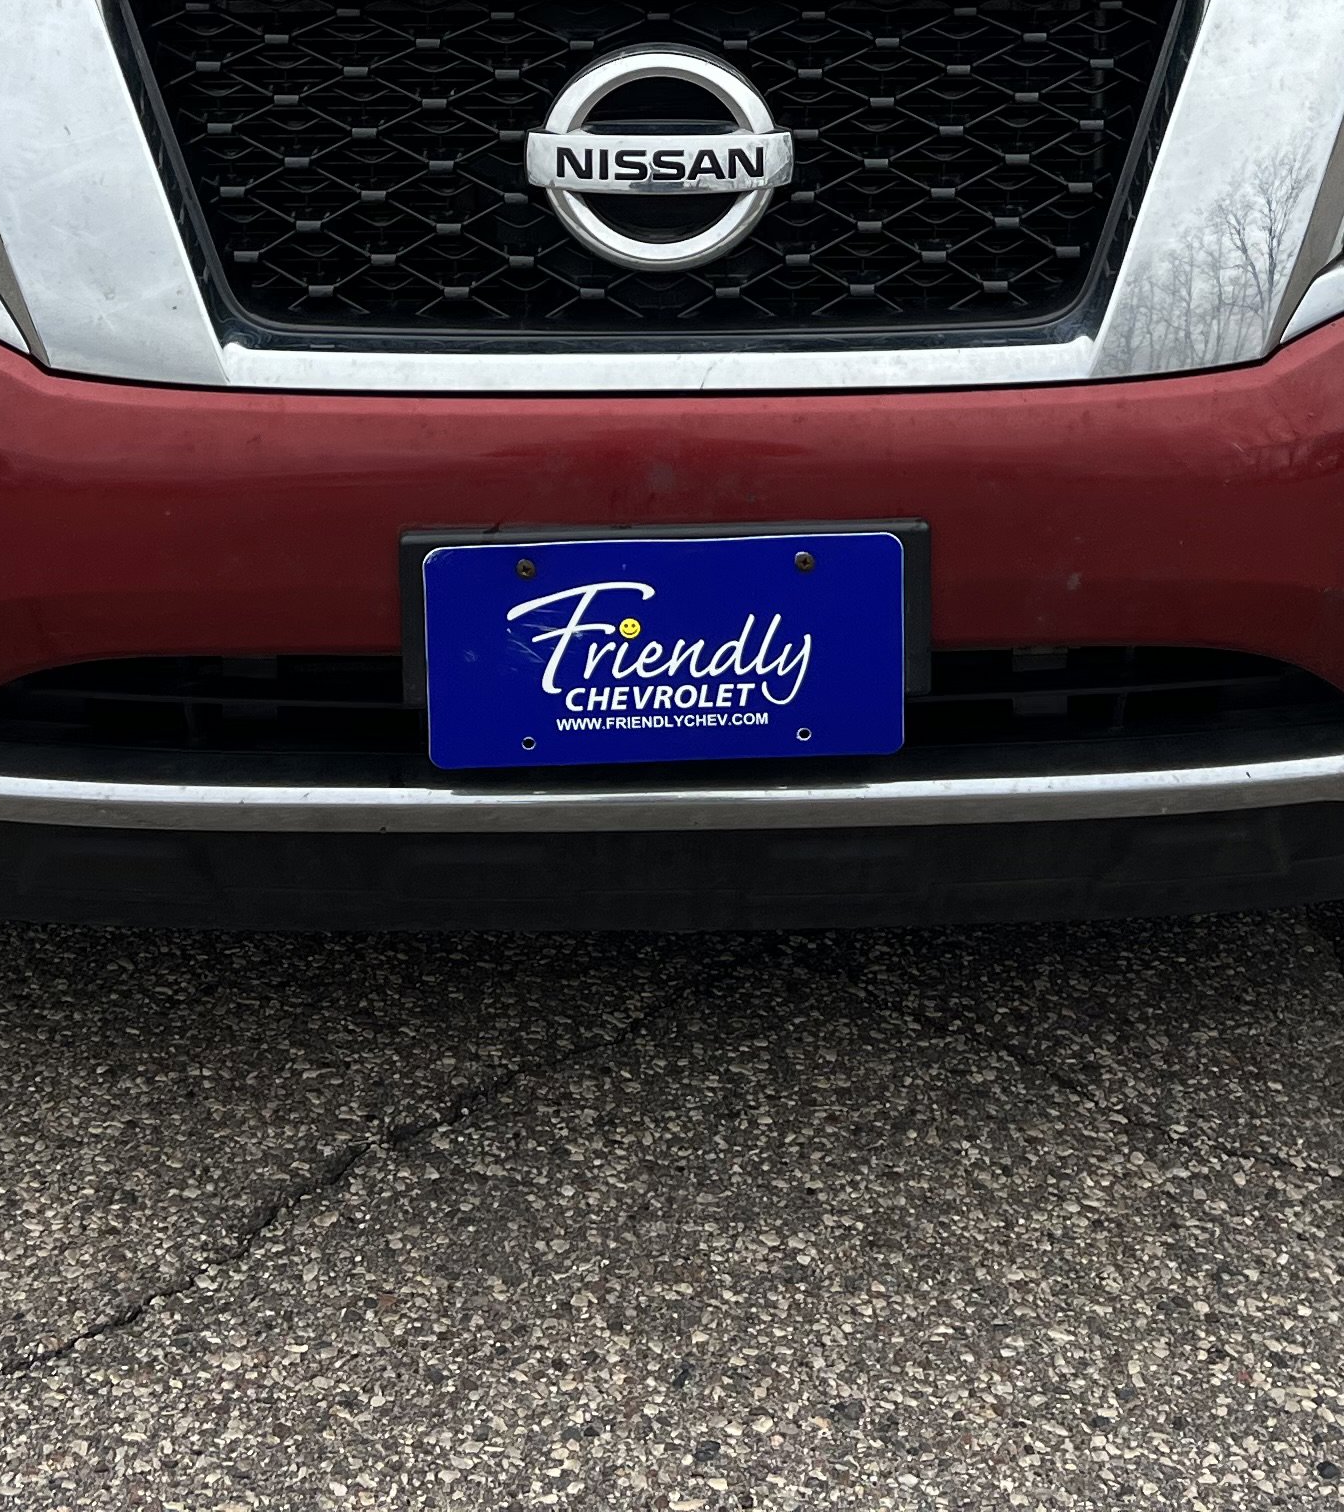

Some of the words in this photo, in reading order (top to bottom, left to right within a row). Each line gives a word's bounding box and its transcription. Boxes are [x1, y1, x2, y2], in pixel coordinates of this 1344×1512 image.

[556, 146, 764, 180] NISSAN
[506, 581, 812, 705] Friendly
[565, 683, 755, 712] CHEVROLET
[556, 712, 769, 731] WWW.FRIENDLYCHEV.COM
